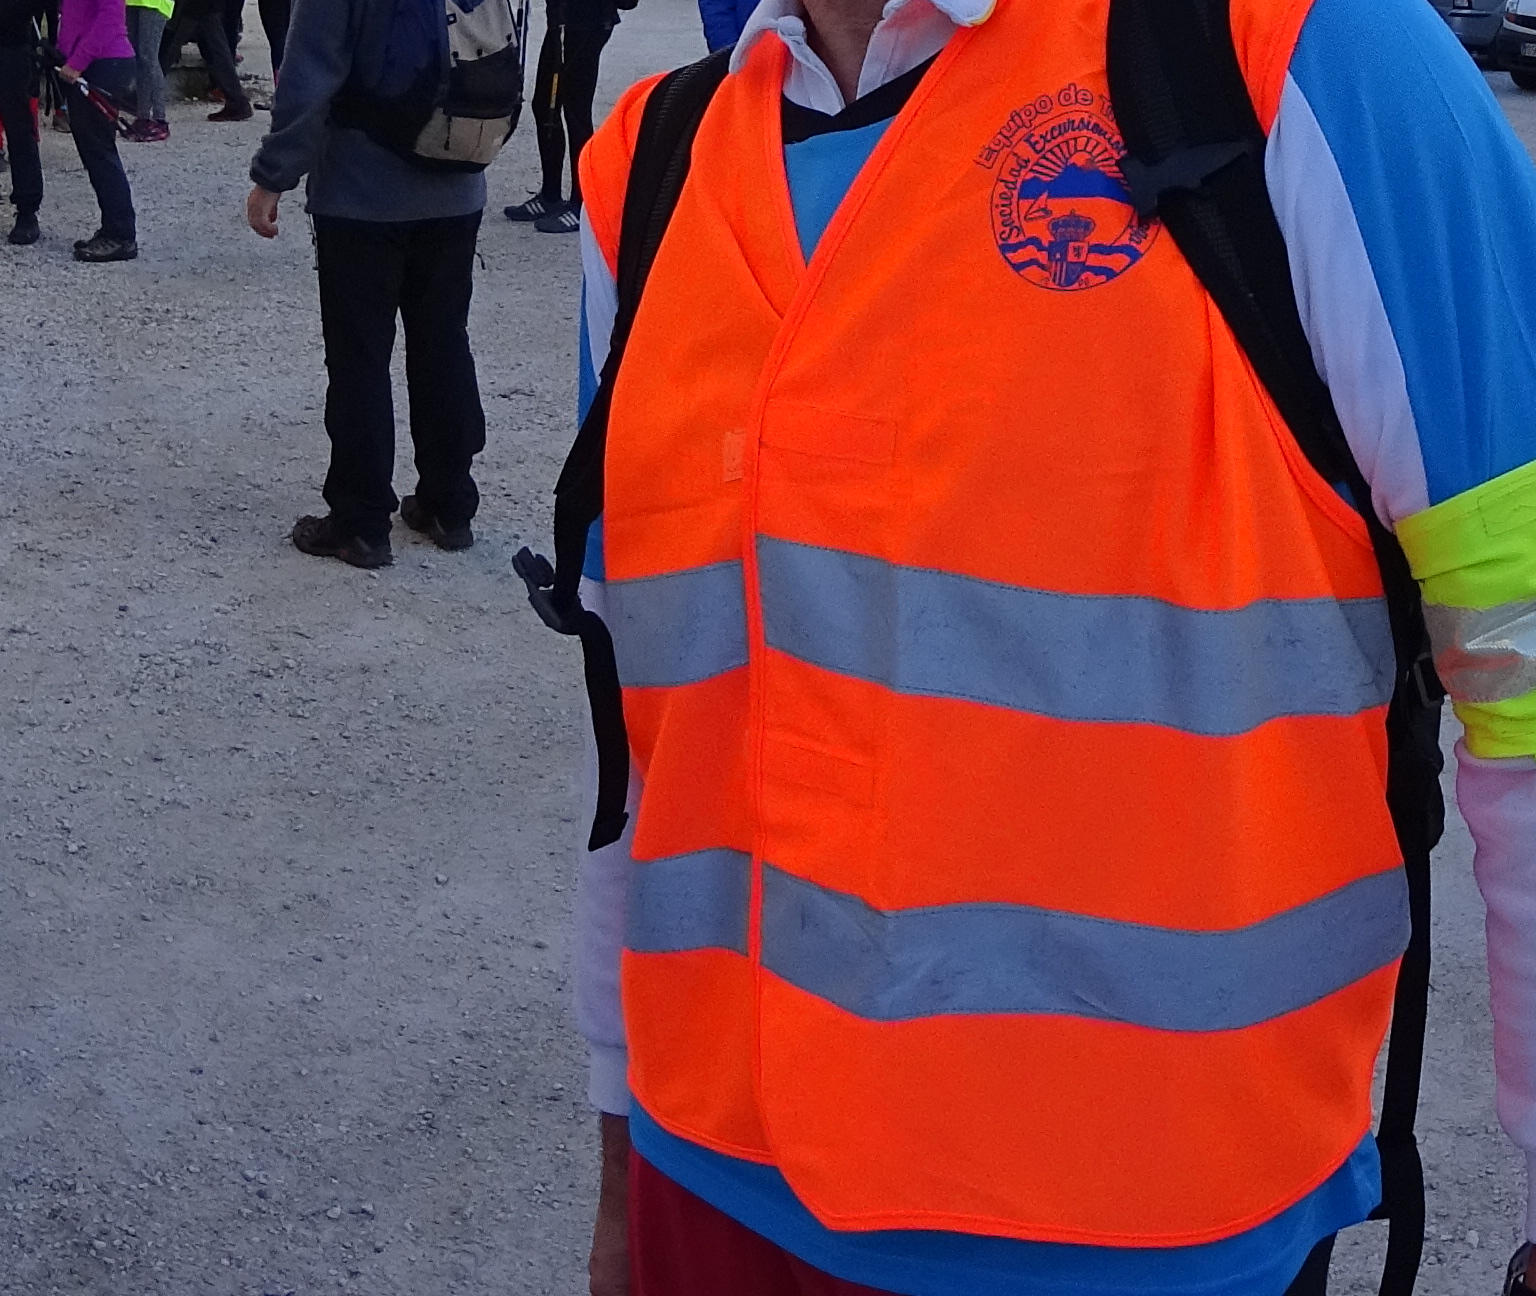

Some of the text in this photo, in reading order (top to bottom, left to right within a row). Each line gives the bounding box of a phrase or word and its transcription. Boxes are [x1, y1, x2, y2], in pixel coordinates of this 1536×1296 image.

[972, 95, 1053, 169] Equipo
[1058, 83, 1093, 106] de
[998, 150, 1030, 241] Sociedad
